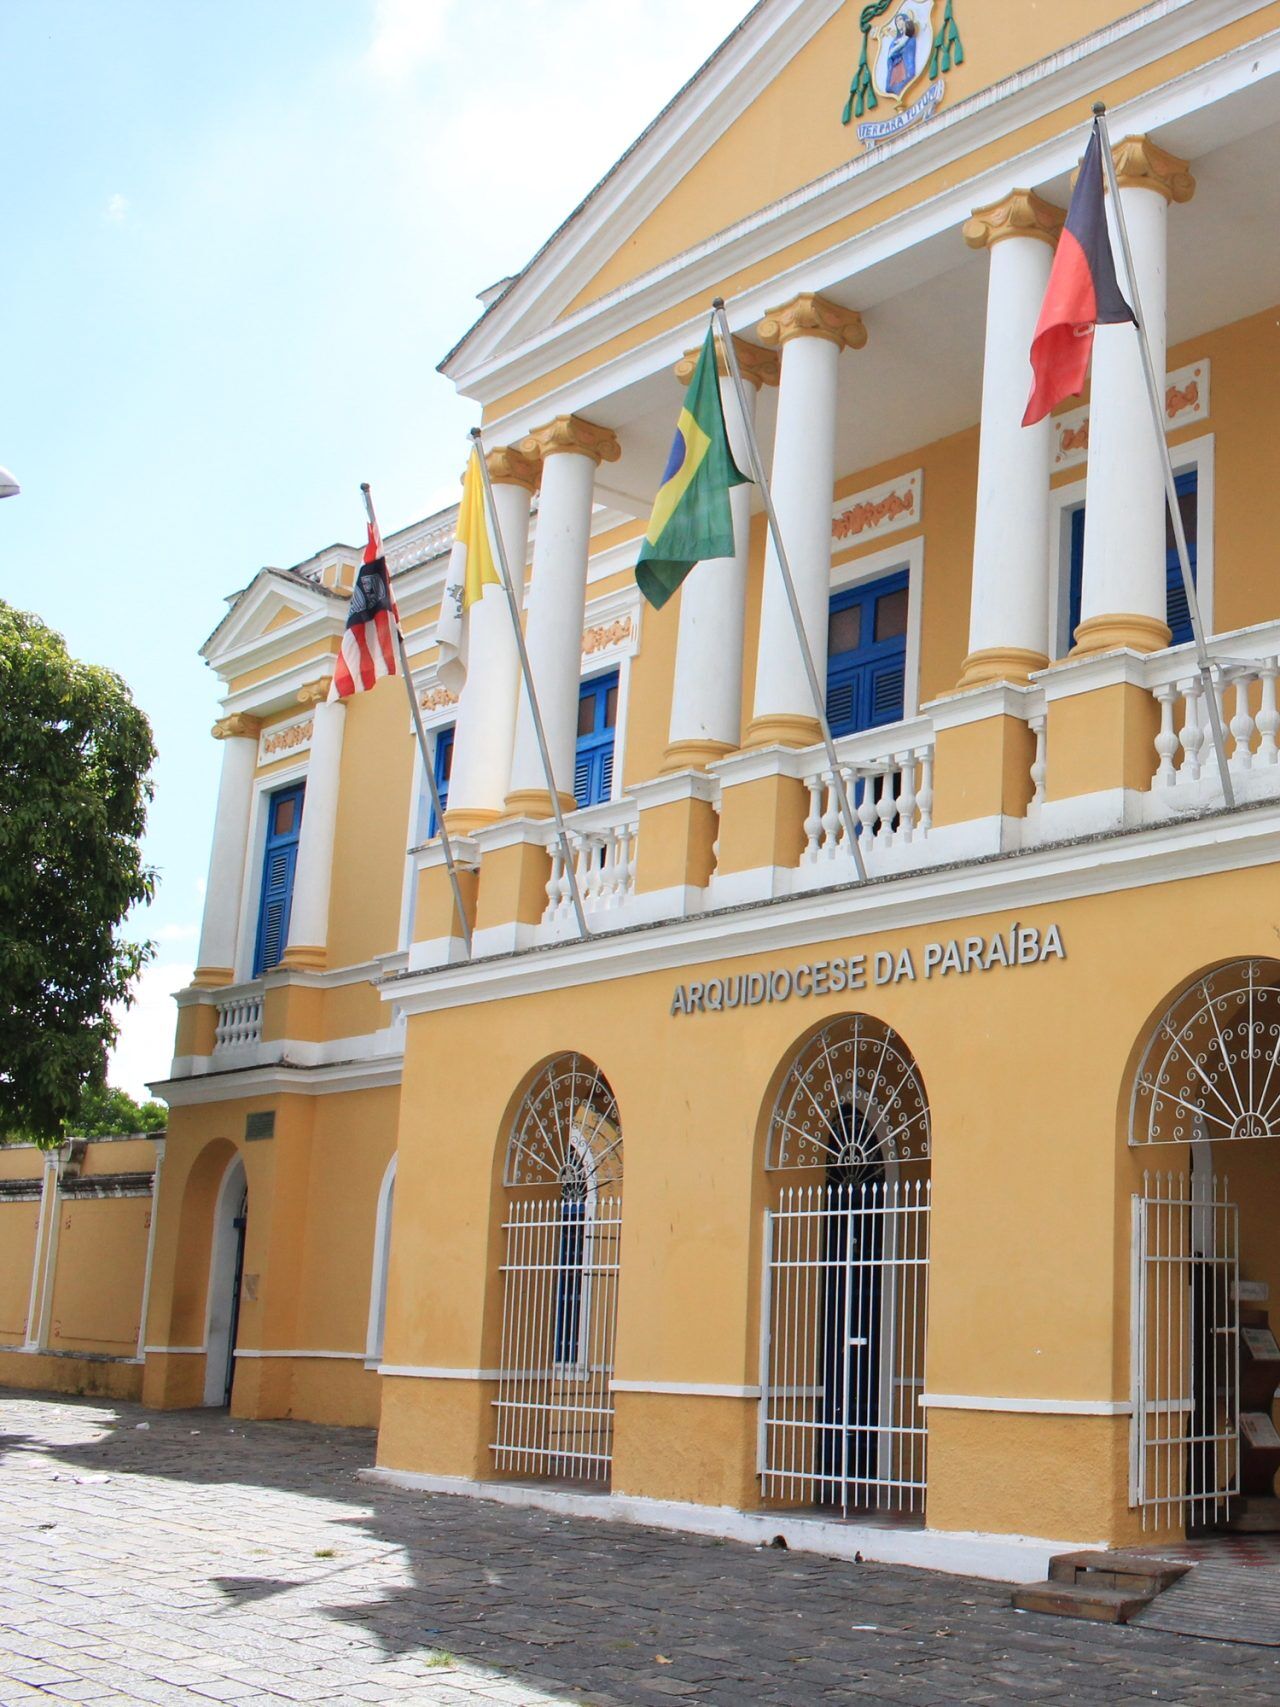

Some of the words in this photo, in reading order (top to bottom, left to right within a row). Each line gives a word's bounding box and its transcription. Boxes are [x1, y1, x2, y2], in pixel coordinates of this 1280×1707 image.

[670, 954, 866, 1016] ARQUIDIOCESE
[873, 947, 915, 986] DA
[924, 922, 1066, 978] PARAÍBA
